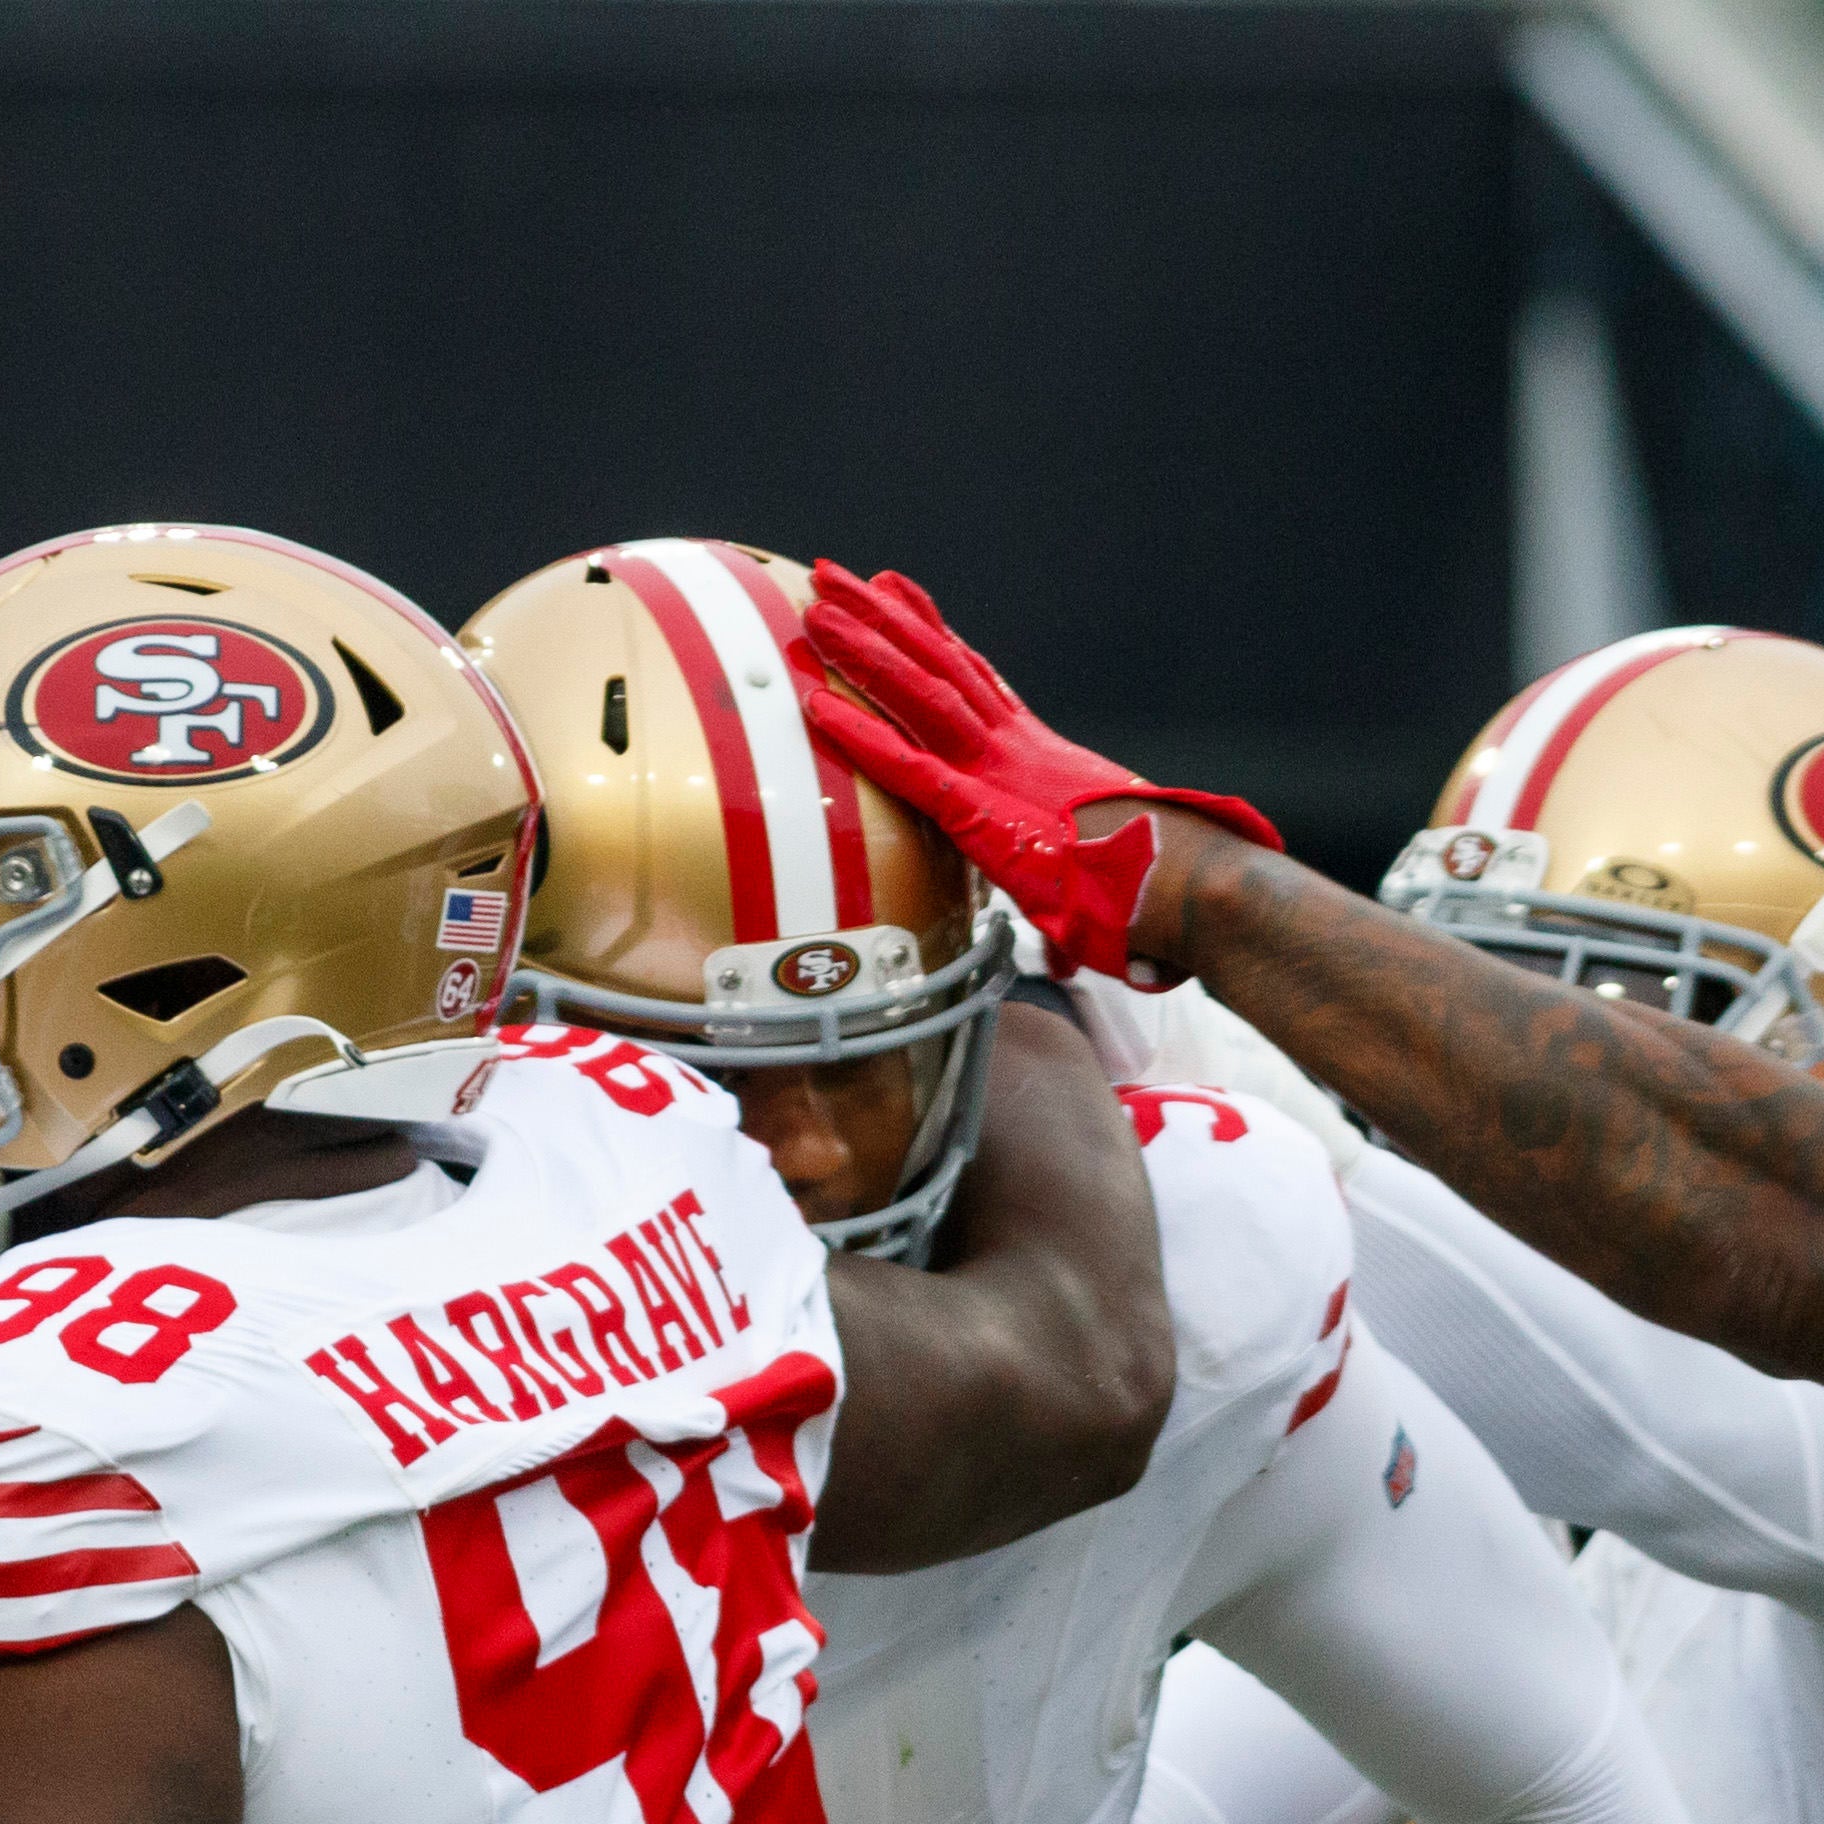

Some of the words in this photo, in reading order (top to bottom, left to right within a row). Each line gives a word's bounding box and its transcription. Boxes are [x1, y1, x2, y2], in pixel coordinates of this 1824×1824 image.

[95, 634, 281, 766] SF
[442, 971, 475, 1008] 64
[303, 1188, 751, 1469] HARGRAVE
